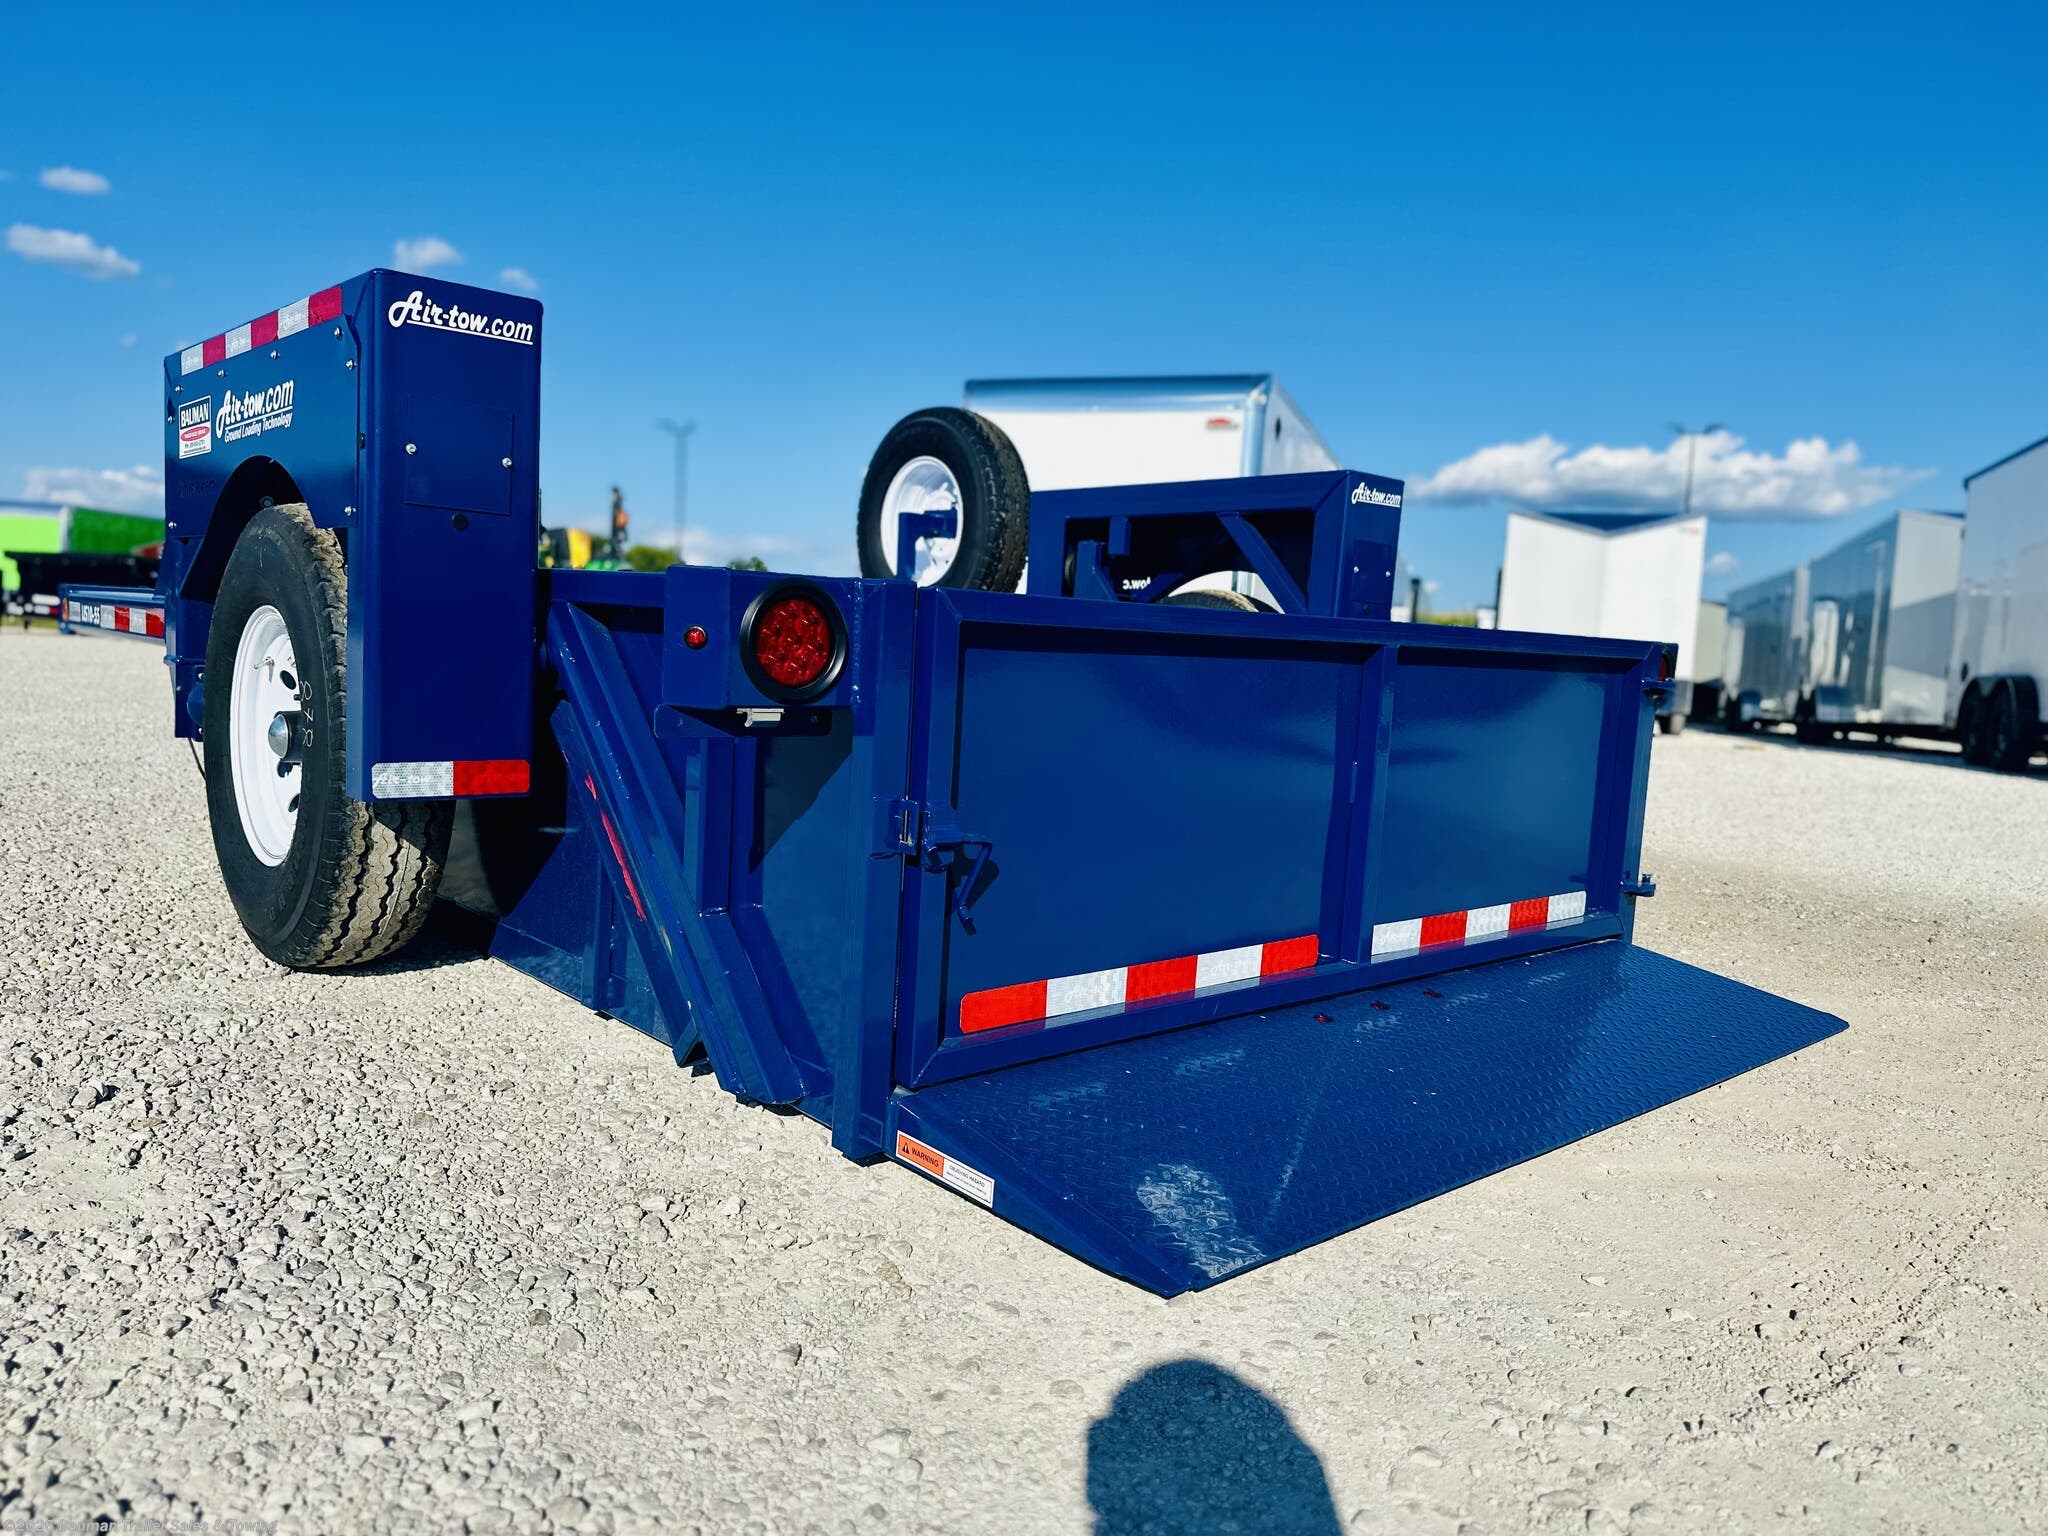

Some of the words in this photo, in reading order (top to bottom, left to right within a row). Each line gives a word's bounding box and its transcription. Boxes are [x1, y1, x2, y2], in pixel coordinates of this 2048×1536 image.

[388, 290, 534, 343] Air-tow.com
[180, 403, 209, 428] BAUMAN
[216, 379, 295, 438] Air-tow.com
[224, 426, 242, 443] Ground
[242, 421, 261, 436] Loading
[262, 412, 293, 432] Technology
[1352, 483, 1402, 506] Air-tow.com
[911, 1147, 939, 1168] WARNING
